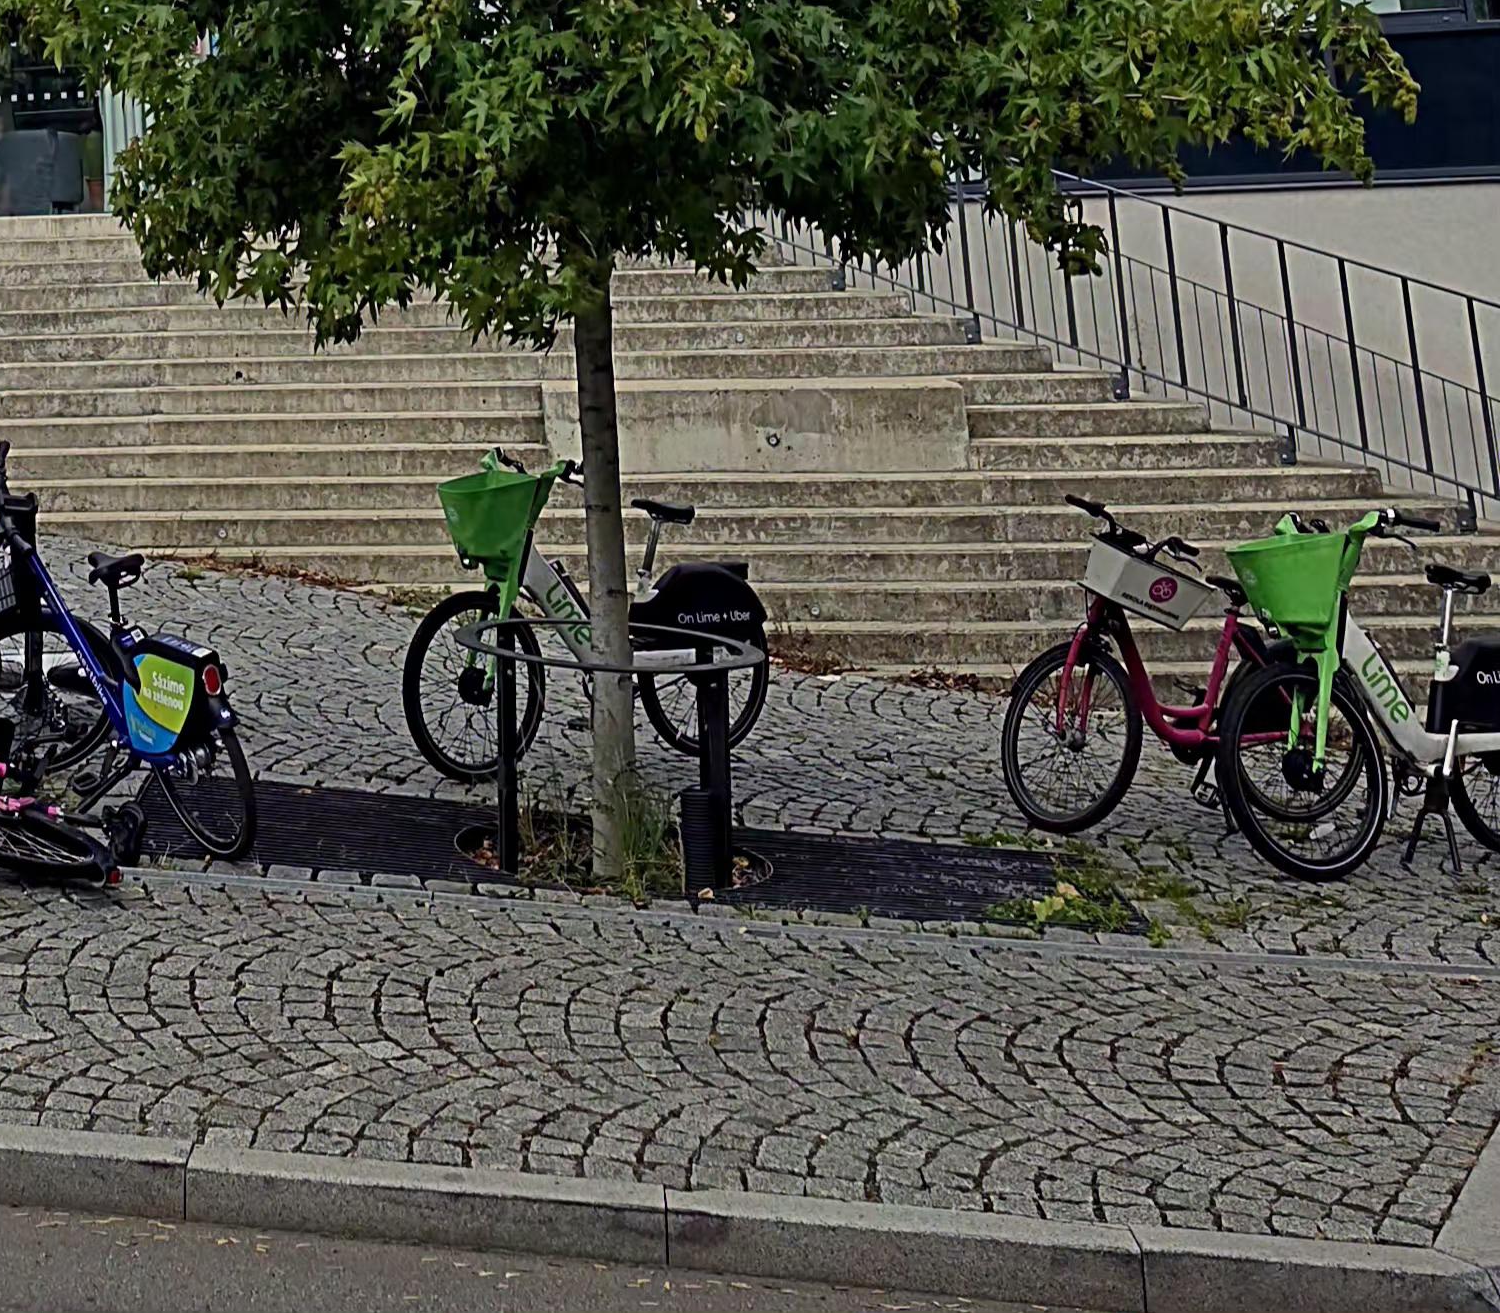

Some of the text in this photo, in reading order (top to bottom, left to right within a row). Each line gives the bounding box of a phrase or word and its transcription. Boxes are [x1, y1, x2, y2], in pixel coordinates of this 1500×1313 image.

[677, 613, 694, 624] On
[696, 611, 720, 623] Lime
[730, 610, 750, 621] Uber
[77, 650, 108, 705] nextbike
[1362, 652, 1409, 724] Lime
[1476, 671, 1493, 684] On
